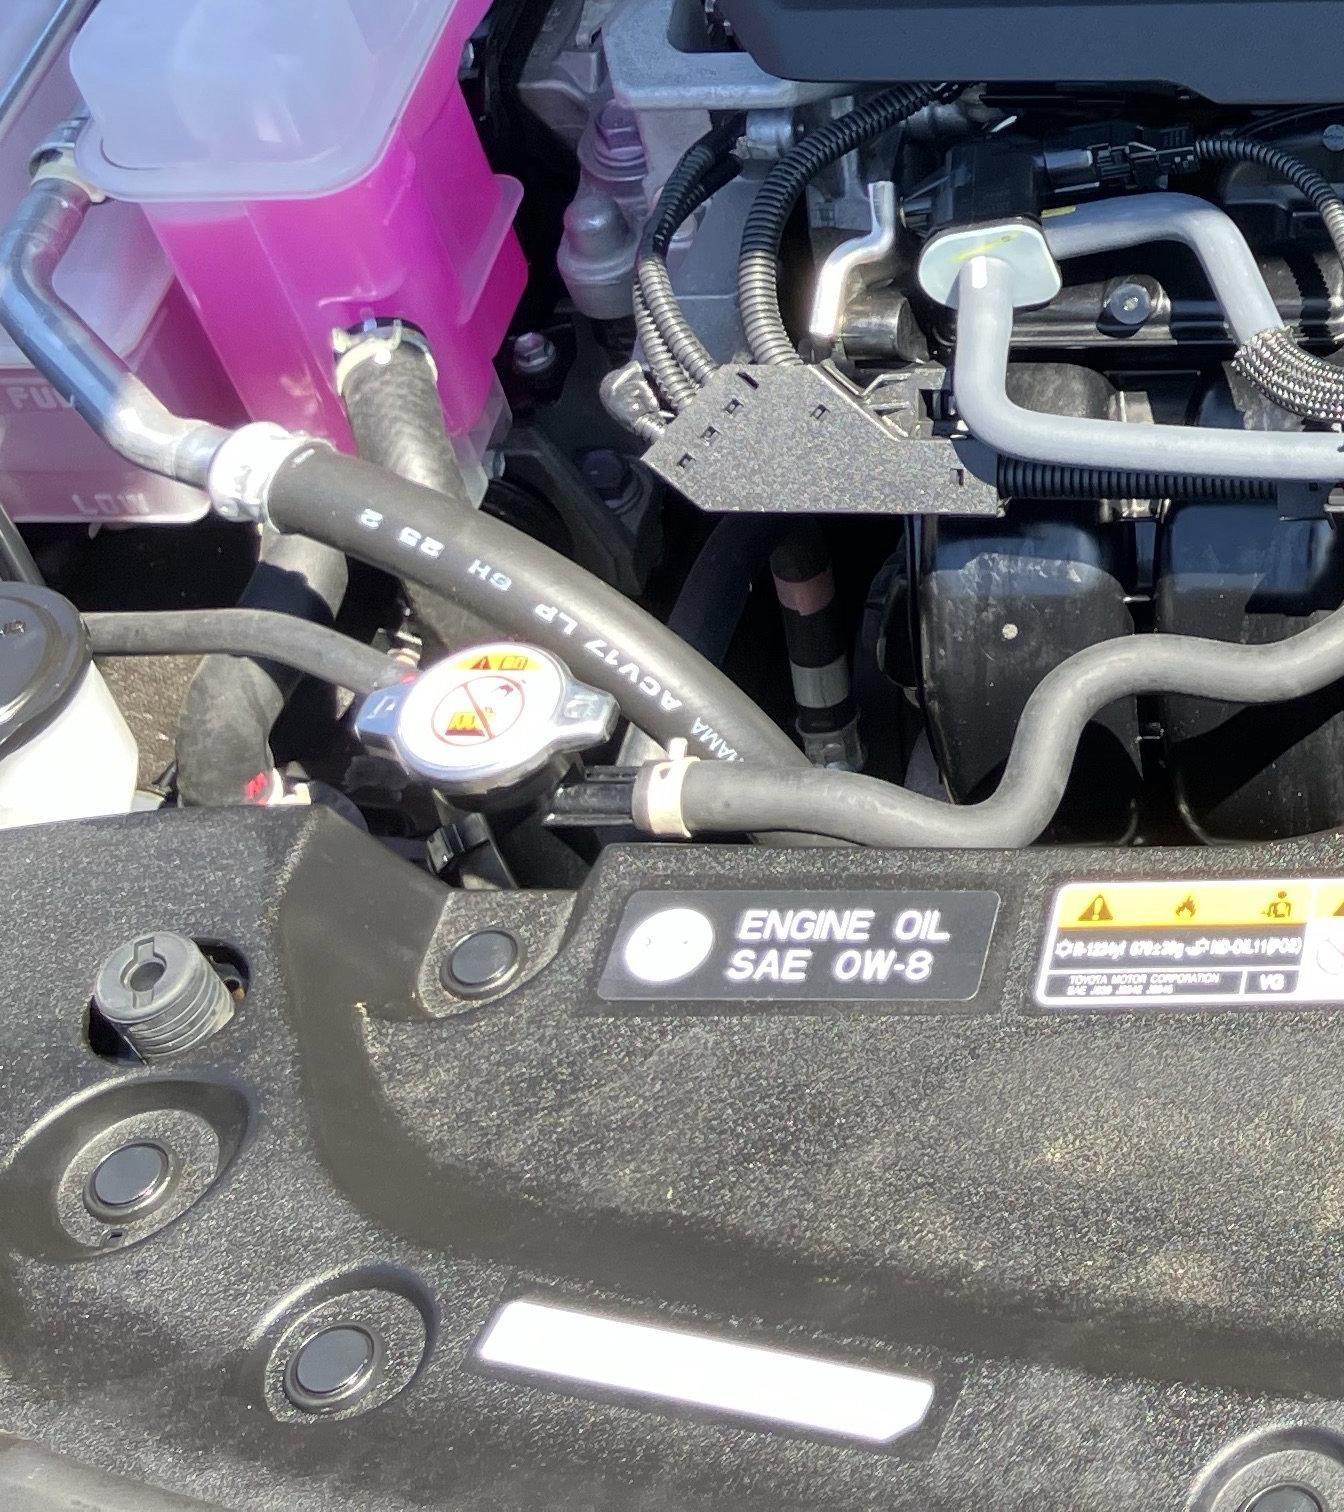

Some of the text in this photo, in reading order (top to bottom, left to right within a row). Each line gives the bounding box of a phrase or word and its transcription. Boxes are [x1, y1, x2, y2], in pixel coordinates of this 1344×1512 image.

[71, 493, 150, 515] LOW
[359, 507, 384, 529] 2
[398, 525, 446, 559] 25
[468, 558, 513, 592] 6H
[534, 602, 579, 635] LP
[584, 639, 683, 713] ACV17
[737, 909, 950, 942] ENGINE OIL
[725, 949, 933, 981] SAE 0W-8
[1070, 972, 1220, 985] TOYOTA MOTOR CORPORATION
[1259, 973, 1285, 990] VG
